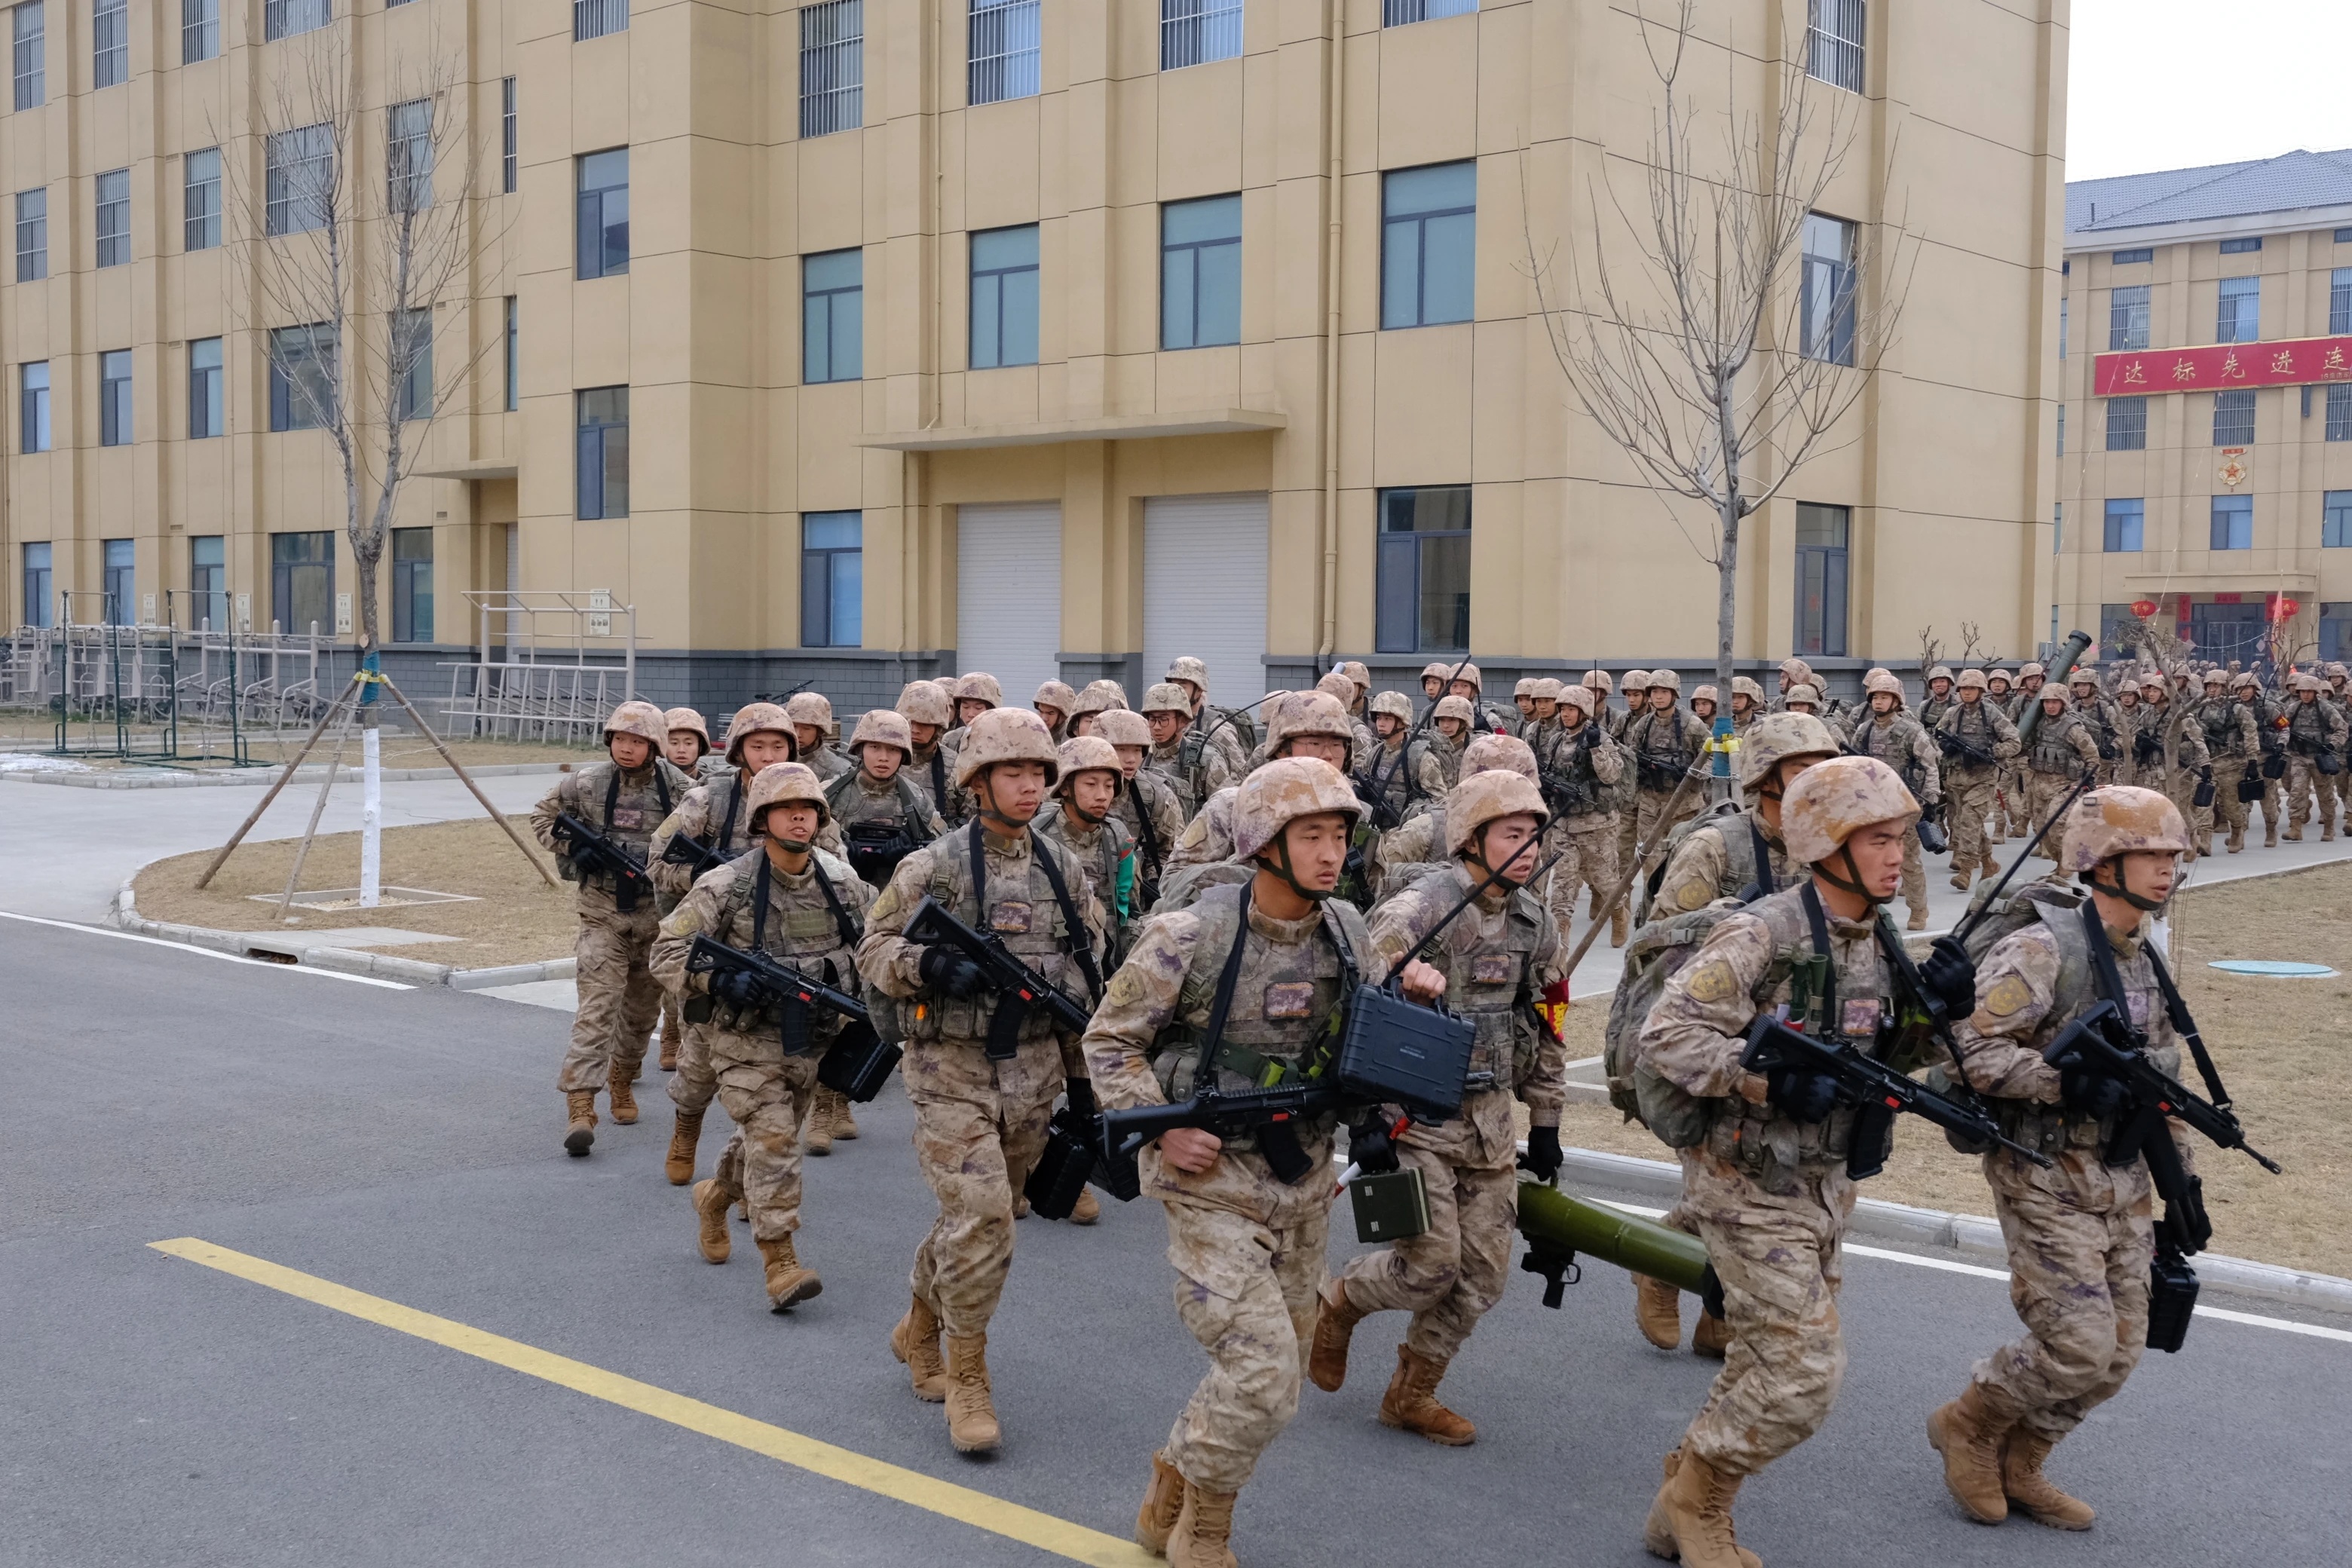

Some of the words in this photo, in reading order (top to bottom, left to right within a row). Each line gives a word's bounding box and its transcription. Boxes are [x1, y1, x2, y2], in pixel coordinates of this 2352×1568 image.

[2124, 346, 2349, 384] 达标先进连
